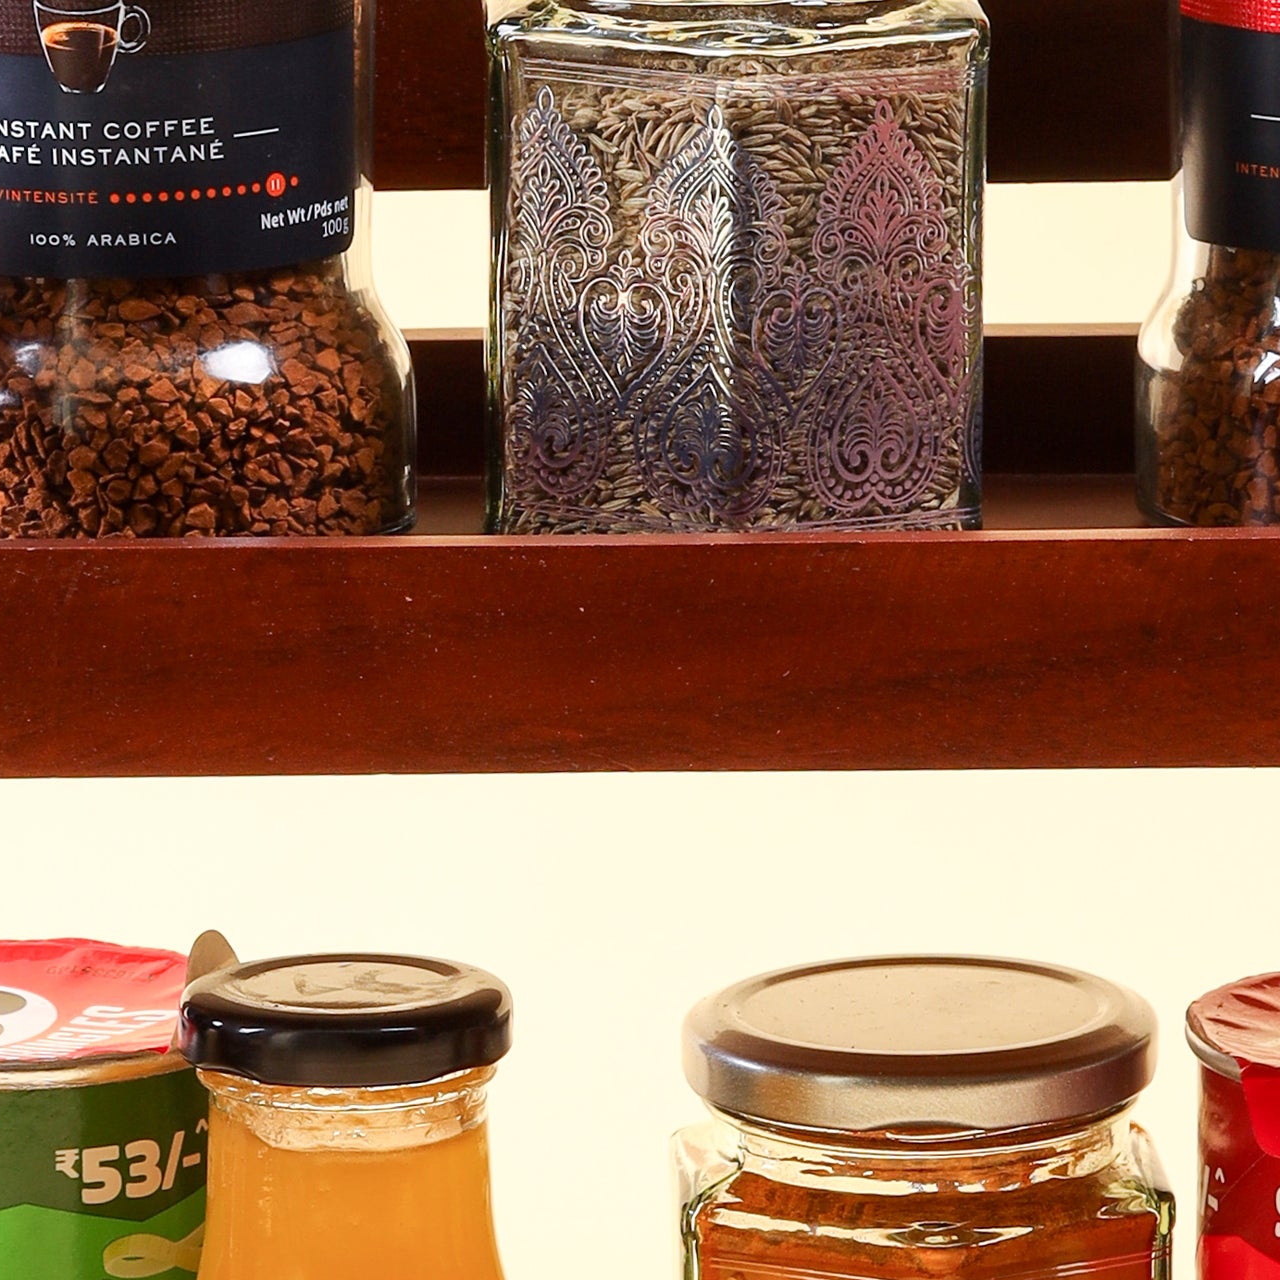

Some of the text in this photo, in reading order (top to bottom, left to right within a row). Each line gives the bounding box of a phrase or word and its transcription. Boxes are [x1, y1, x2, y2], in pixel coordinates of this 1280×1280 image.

[103, 117, 215, 140] COFFEE
[52, 138, 224, 166] INSTANTANÉ
[260, 213, 285, 230] Net
[334, 196, 349, 213] net
[30, 231, 177, 247] 100% ARABICA
[322, 217, 349, 238] 100g
